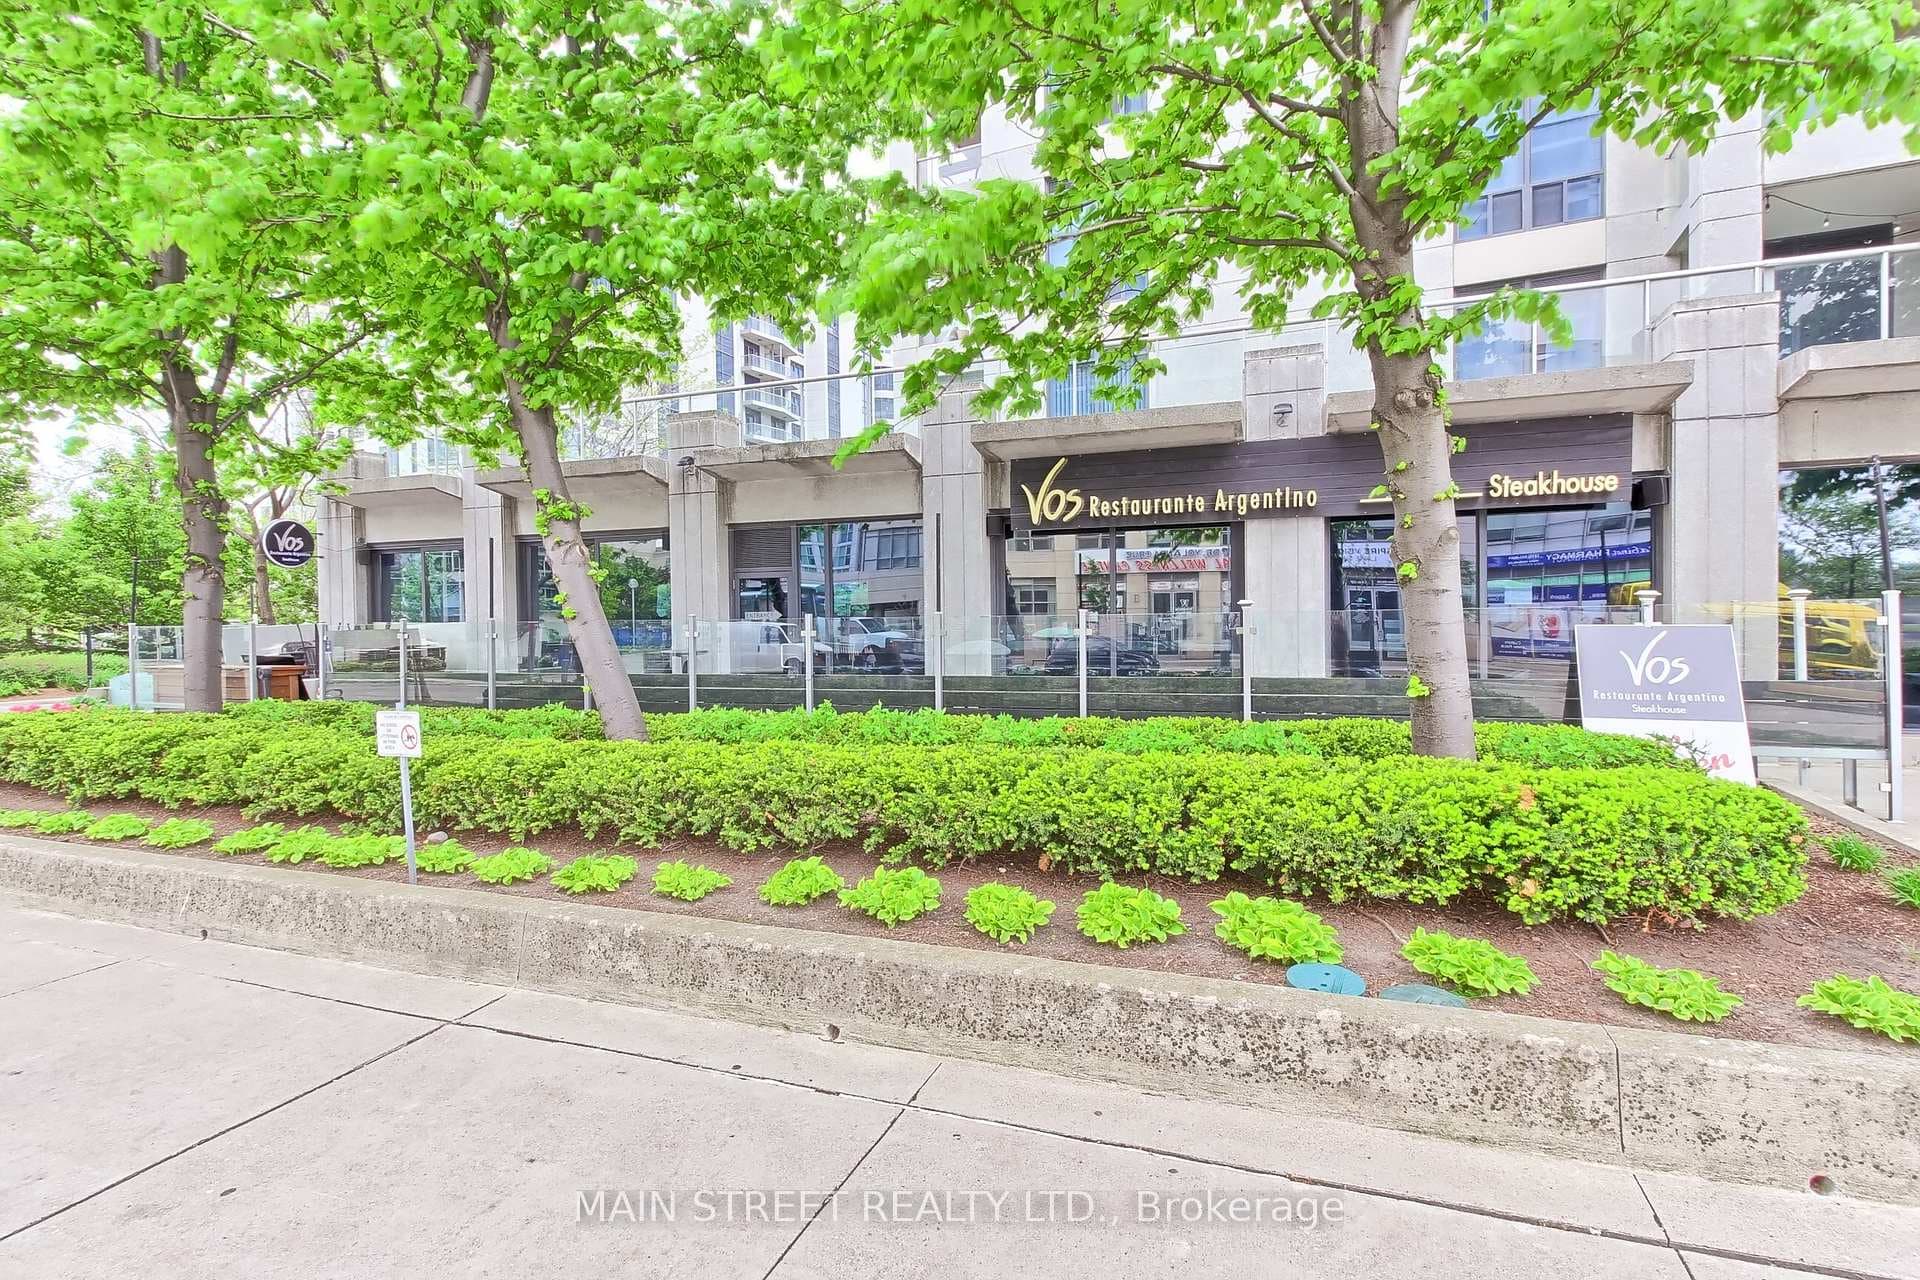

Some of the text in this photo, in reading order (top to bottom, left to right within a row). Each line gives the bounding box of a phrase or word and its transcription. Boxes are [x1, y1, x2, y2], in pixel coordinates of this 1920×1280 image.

[1489, 469, 1619, 497] Steakhouse
[1089, 487, 1318, 517] Restaurante Argentino
[1593, 689, 1726, 703] Restaurante Argentino
[1631, 703, 1687, 714] Steakhouse
